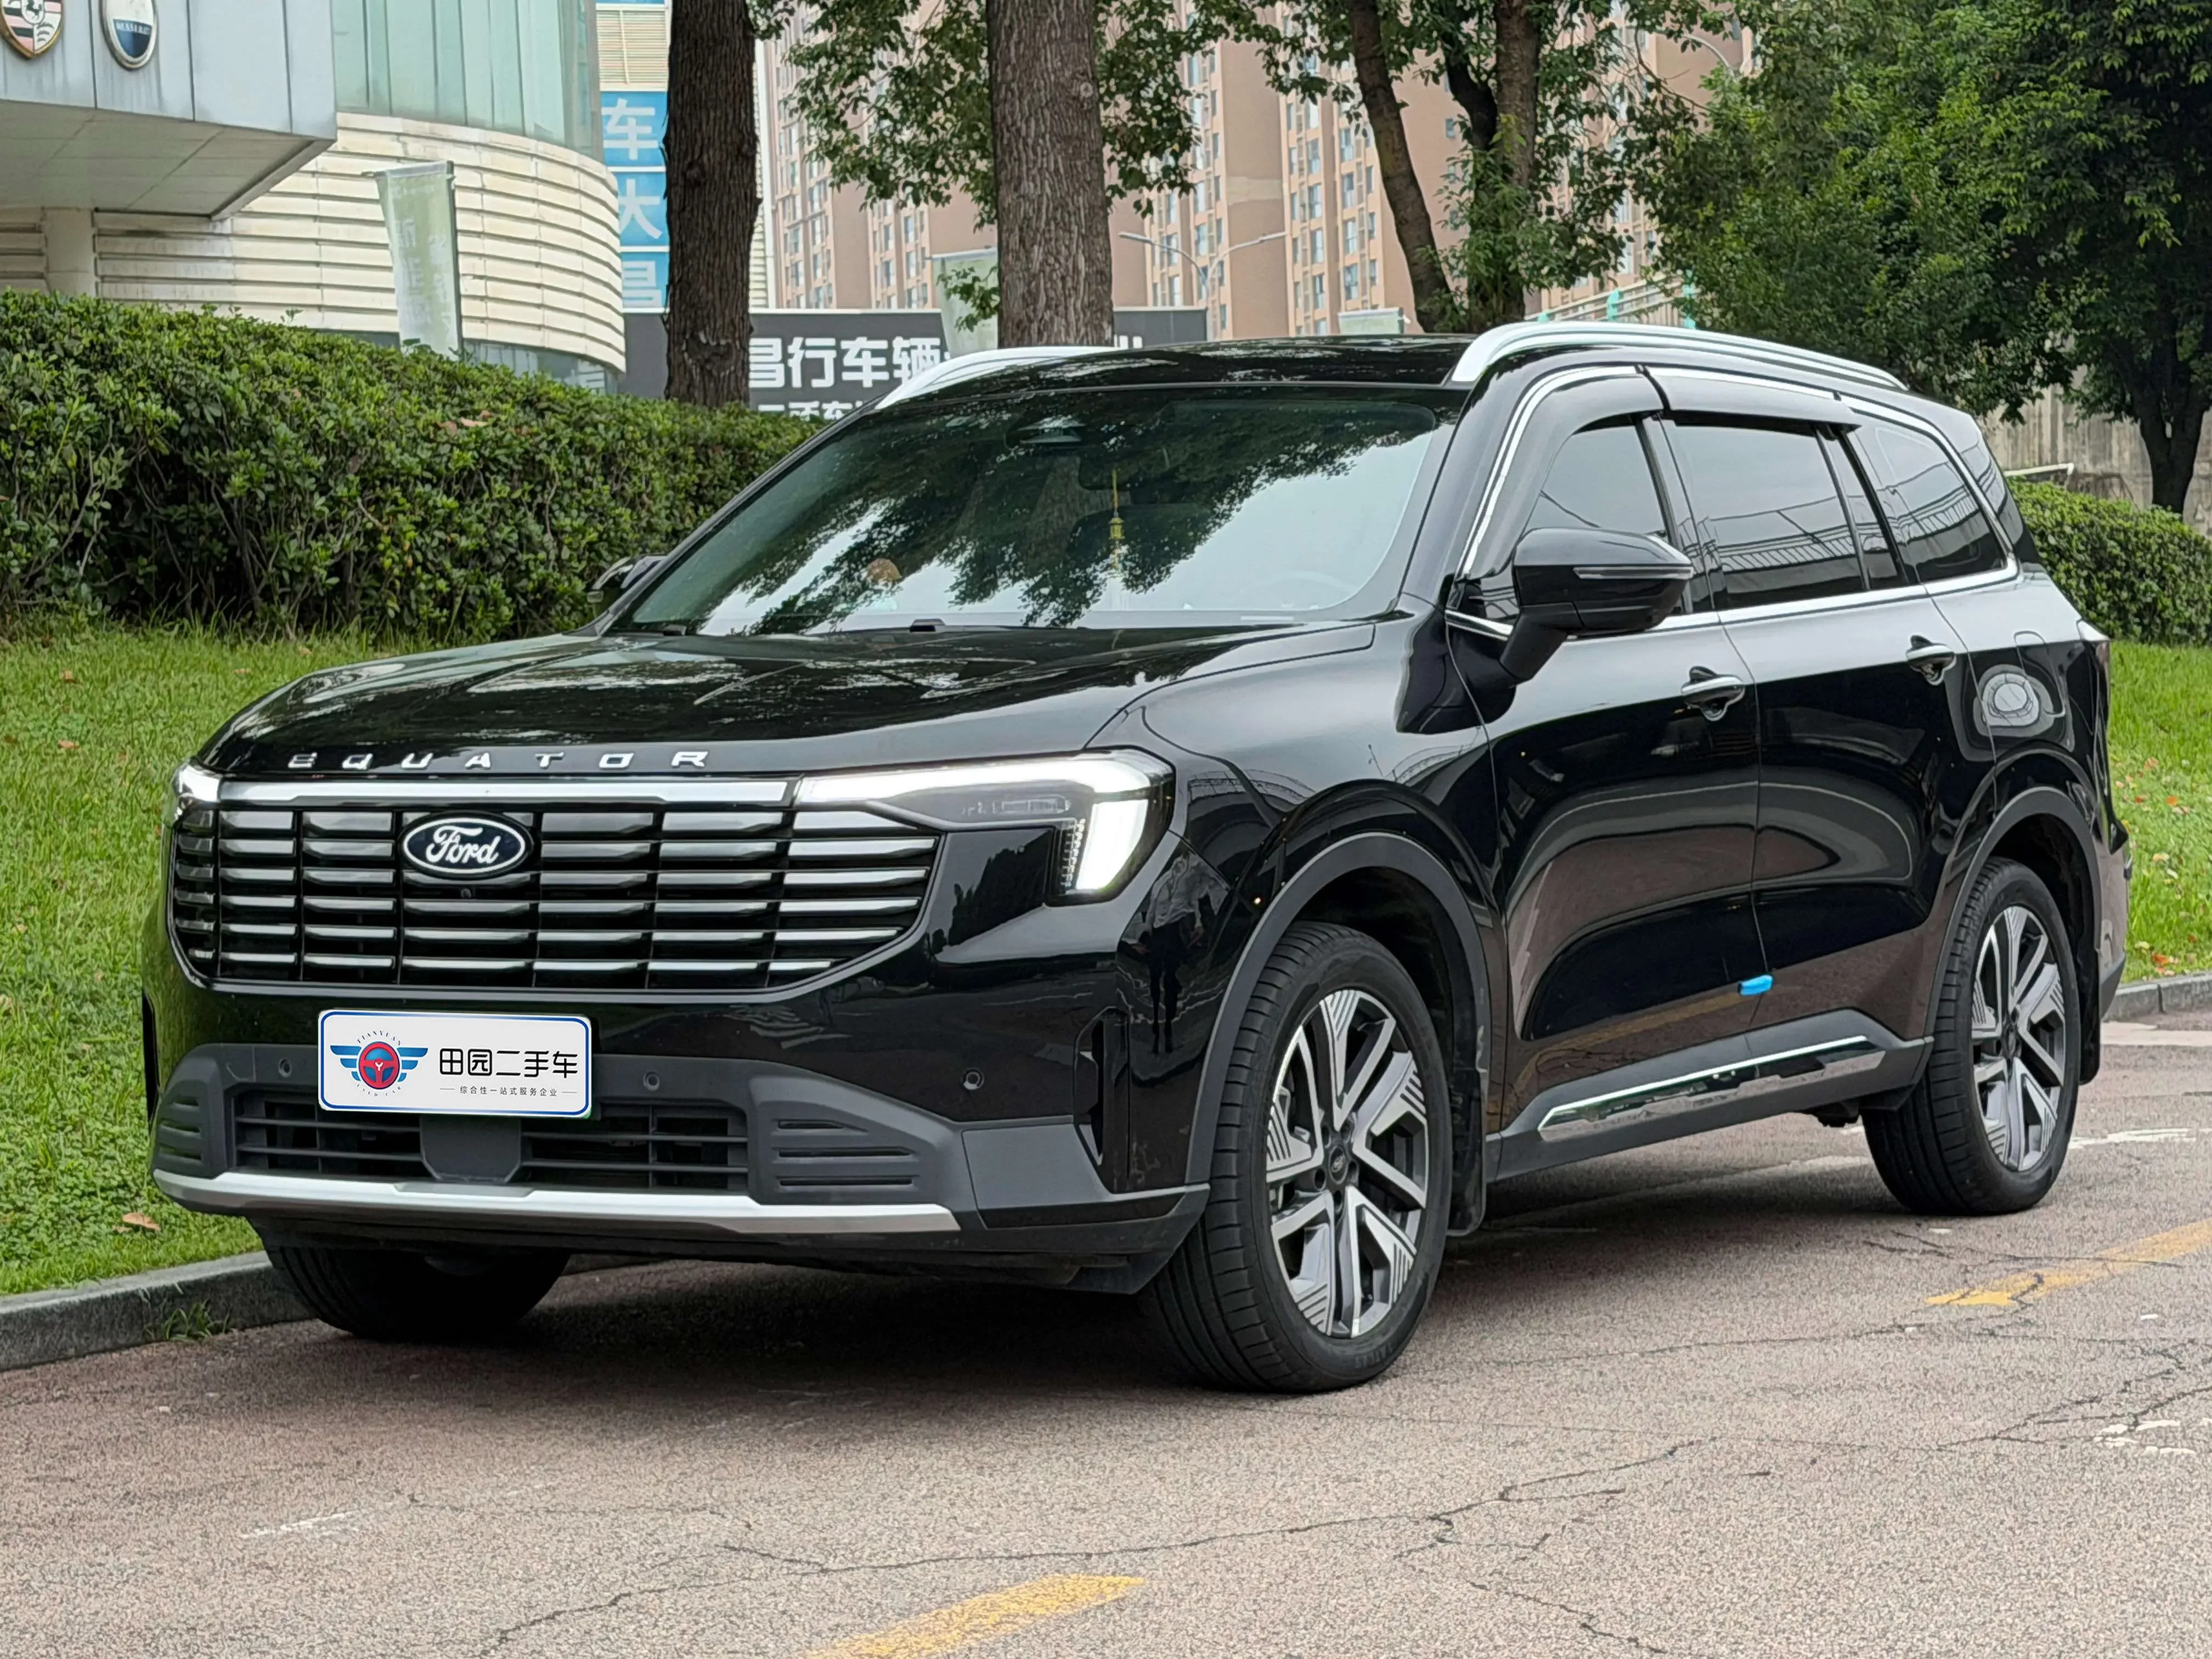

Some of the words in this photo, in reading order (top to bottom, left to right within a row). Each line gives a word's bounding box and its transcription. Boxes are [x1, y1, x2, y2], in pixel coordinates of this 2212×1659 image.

[749, 336, 950, 388] 昌行车辆
[287, 751, 709, 770] EQUATOR
[426, 825, 501, 863] Ford
[439, 1048, 578, 1079] 田园二手车
[460, 1086, 557, 1097] 综合性一站式服务企业
